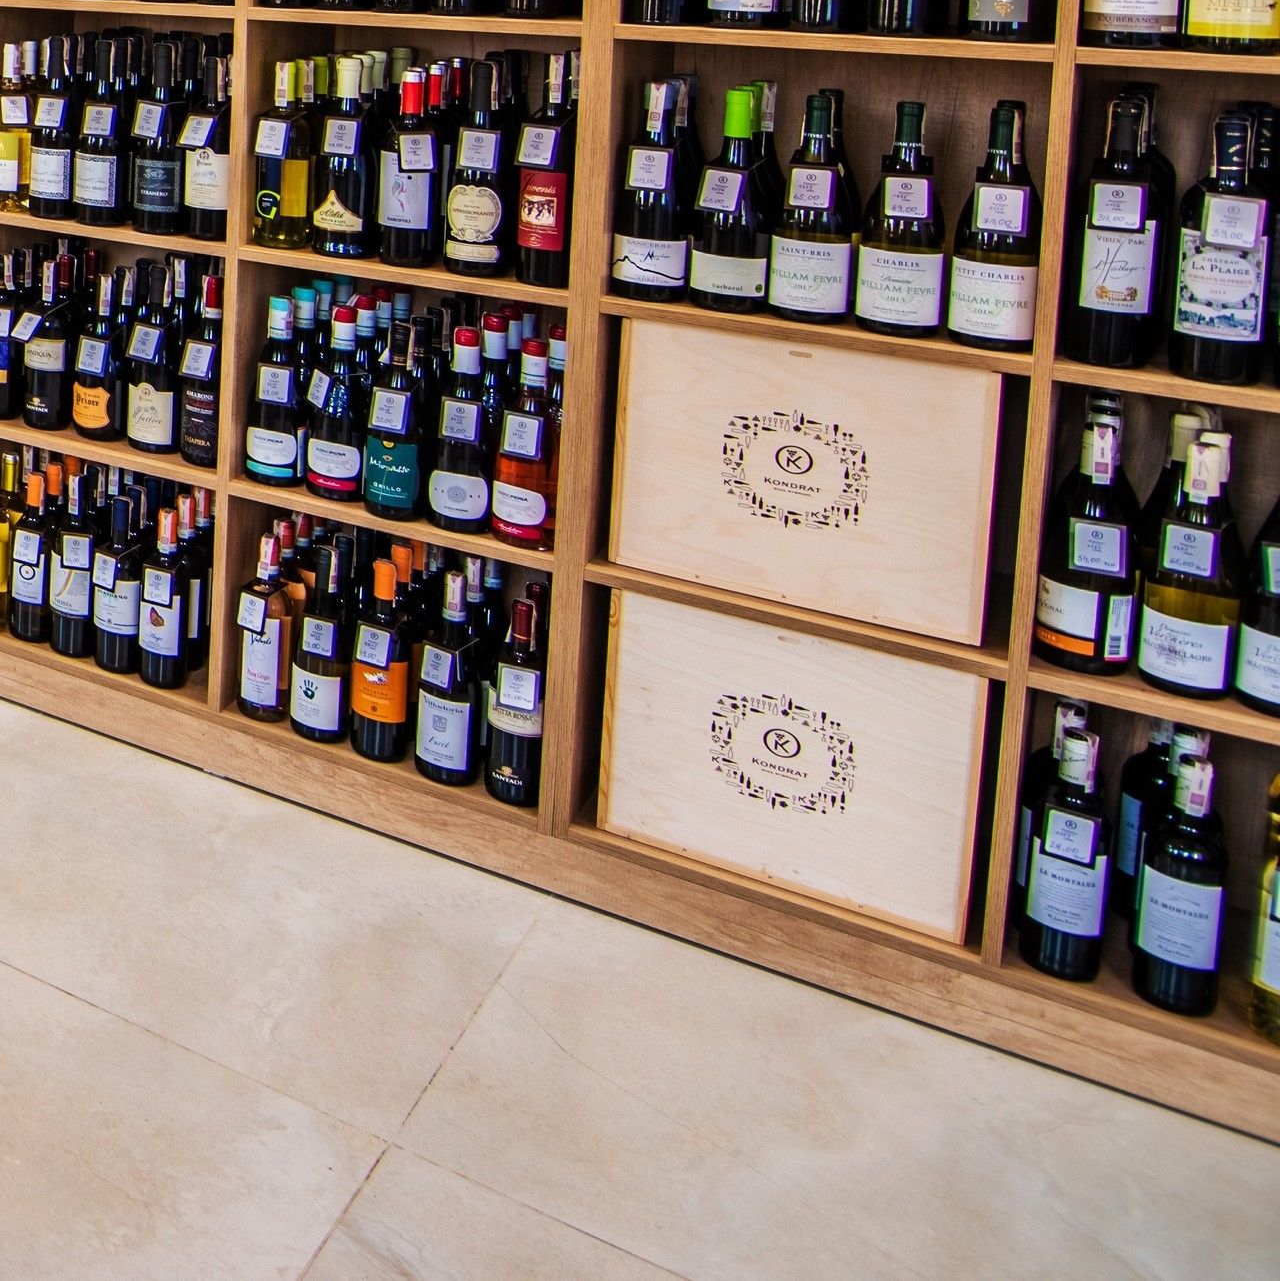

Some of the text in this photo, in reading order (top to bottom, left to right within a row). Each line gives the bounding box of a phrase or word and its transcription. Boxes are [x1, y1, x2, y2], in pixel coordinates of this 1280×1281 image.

[1096, 233, 1123, 246] VIEUX
[780, 245, 833, 258] SAINT-BRIS
[875, 257, 921, 269] CHABLIS
[1191, 260, 1252, 277] LA PLAIGE
[812, 274, 844, 286] FEVRE
[979, 269, 1027, 282] CHABLIS
[859, 278, 937, 297] WILLIAM FEVRE
[950, 289, 1030, 310] WILLIAM FEVRE
[185, 389, 215, 401] AMARONE
[372, 480, 402, 494] GRILLO
[763, 476, 821, 494] KONDRAT
[751, 757, 810, 779] KONDRAT
[491, 770, 524, 786] SANTADI
